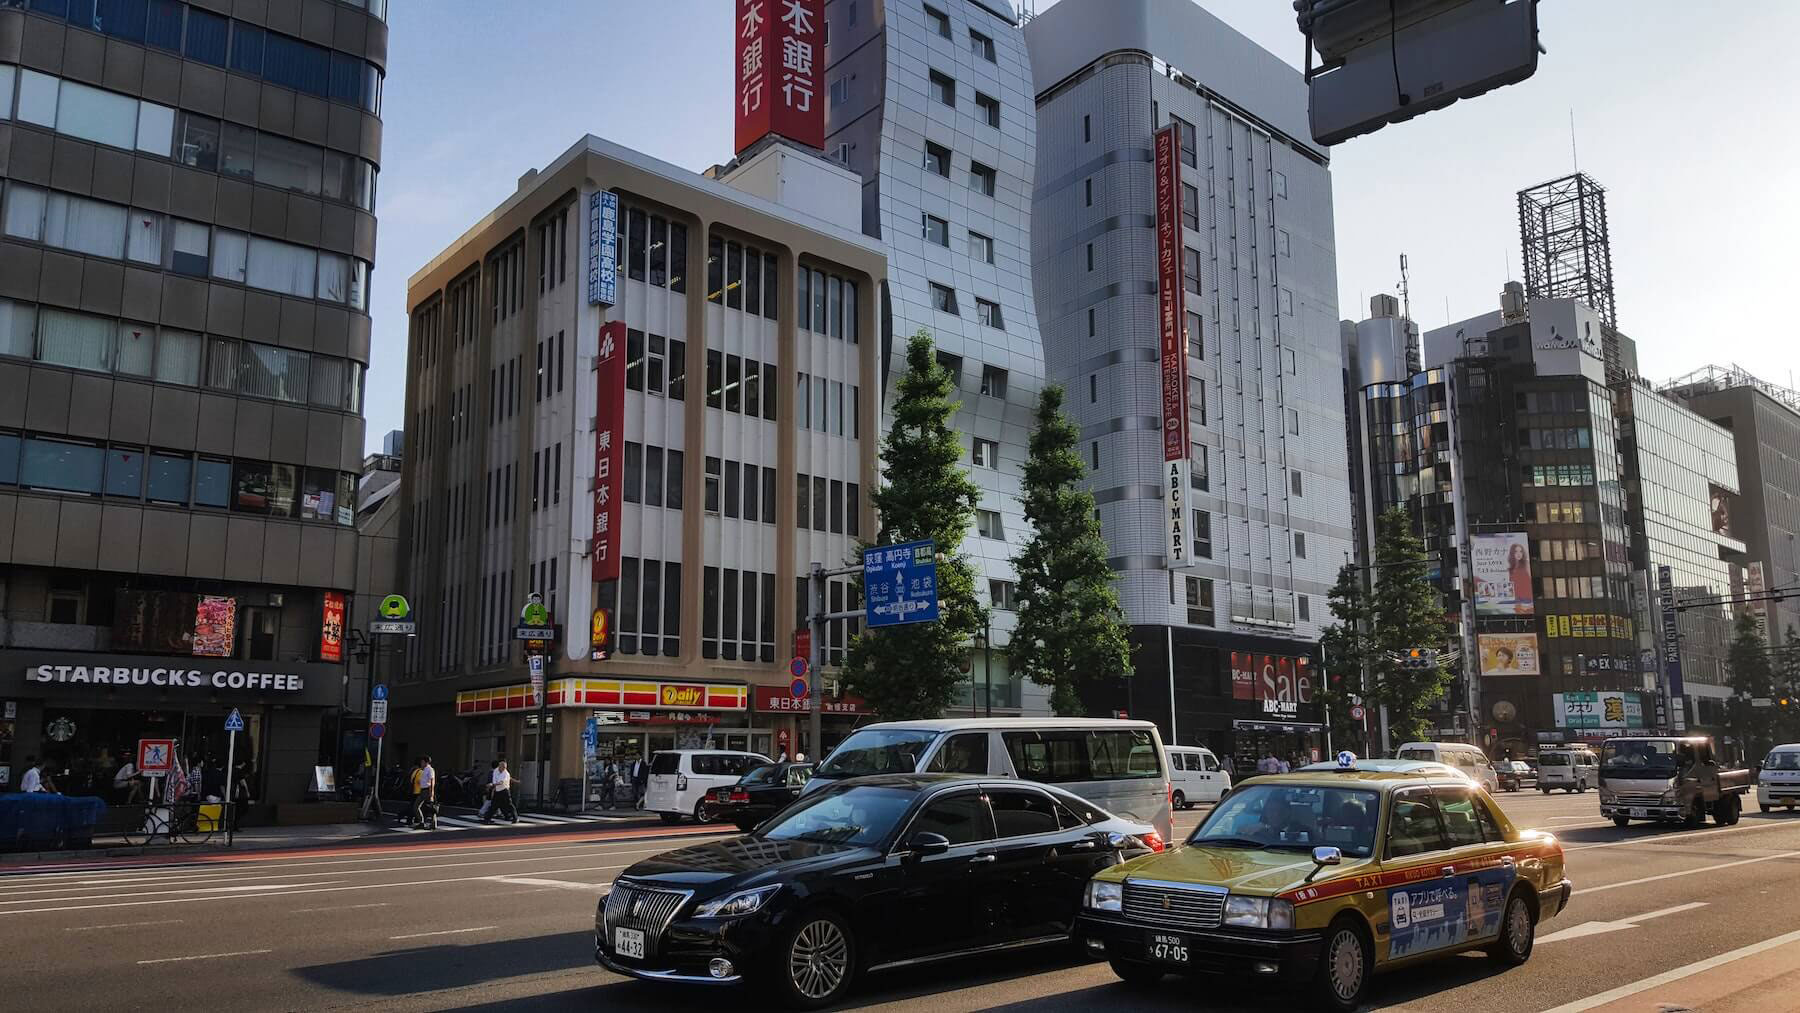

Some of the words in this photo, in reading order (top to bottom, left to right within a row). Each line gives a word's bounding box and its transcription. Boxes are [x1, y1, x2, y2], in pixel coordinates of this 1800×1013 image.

[742, 0, 764, 117] 本銀行
[595, 430, 612, 562] 東日本銀行
[886, 548, 911, 562] 高円寺
[870, 582, 889, 595] 渋谷
[911, 576, 932, 590] 池袋
[1665, 620, 1677, 640] CITY
[1666, 642, 1679, 663] PARK
[37, 664, 201, 687] STARBUCKS
[211, 671, 299, 690] COFFEE
[1263, 664, 1312, 703] Sale
[662, 686, 701, 704] Daily
[770, 697, 811, 710] 東日本銀
[1263, 699, 1298, 713] ABC-MART
[1356, 875, 1383, 887] TAXI
[1155, 944, 1188, 961] 67-05
